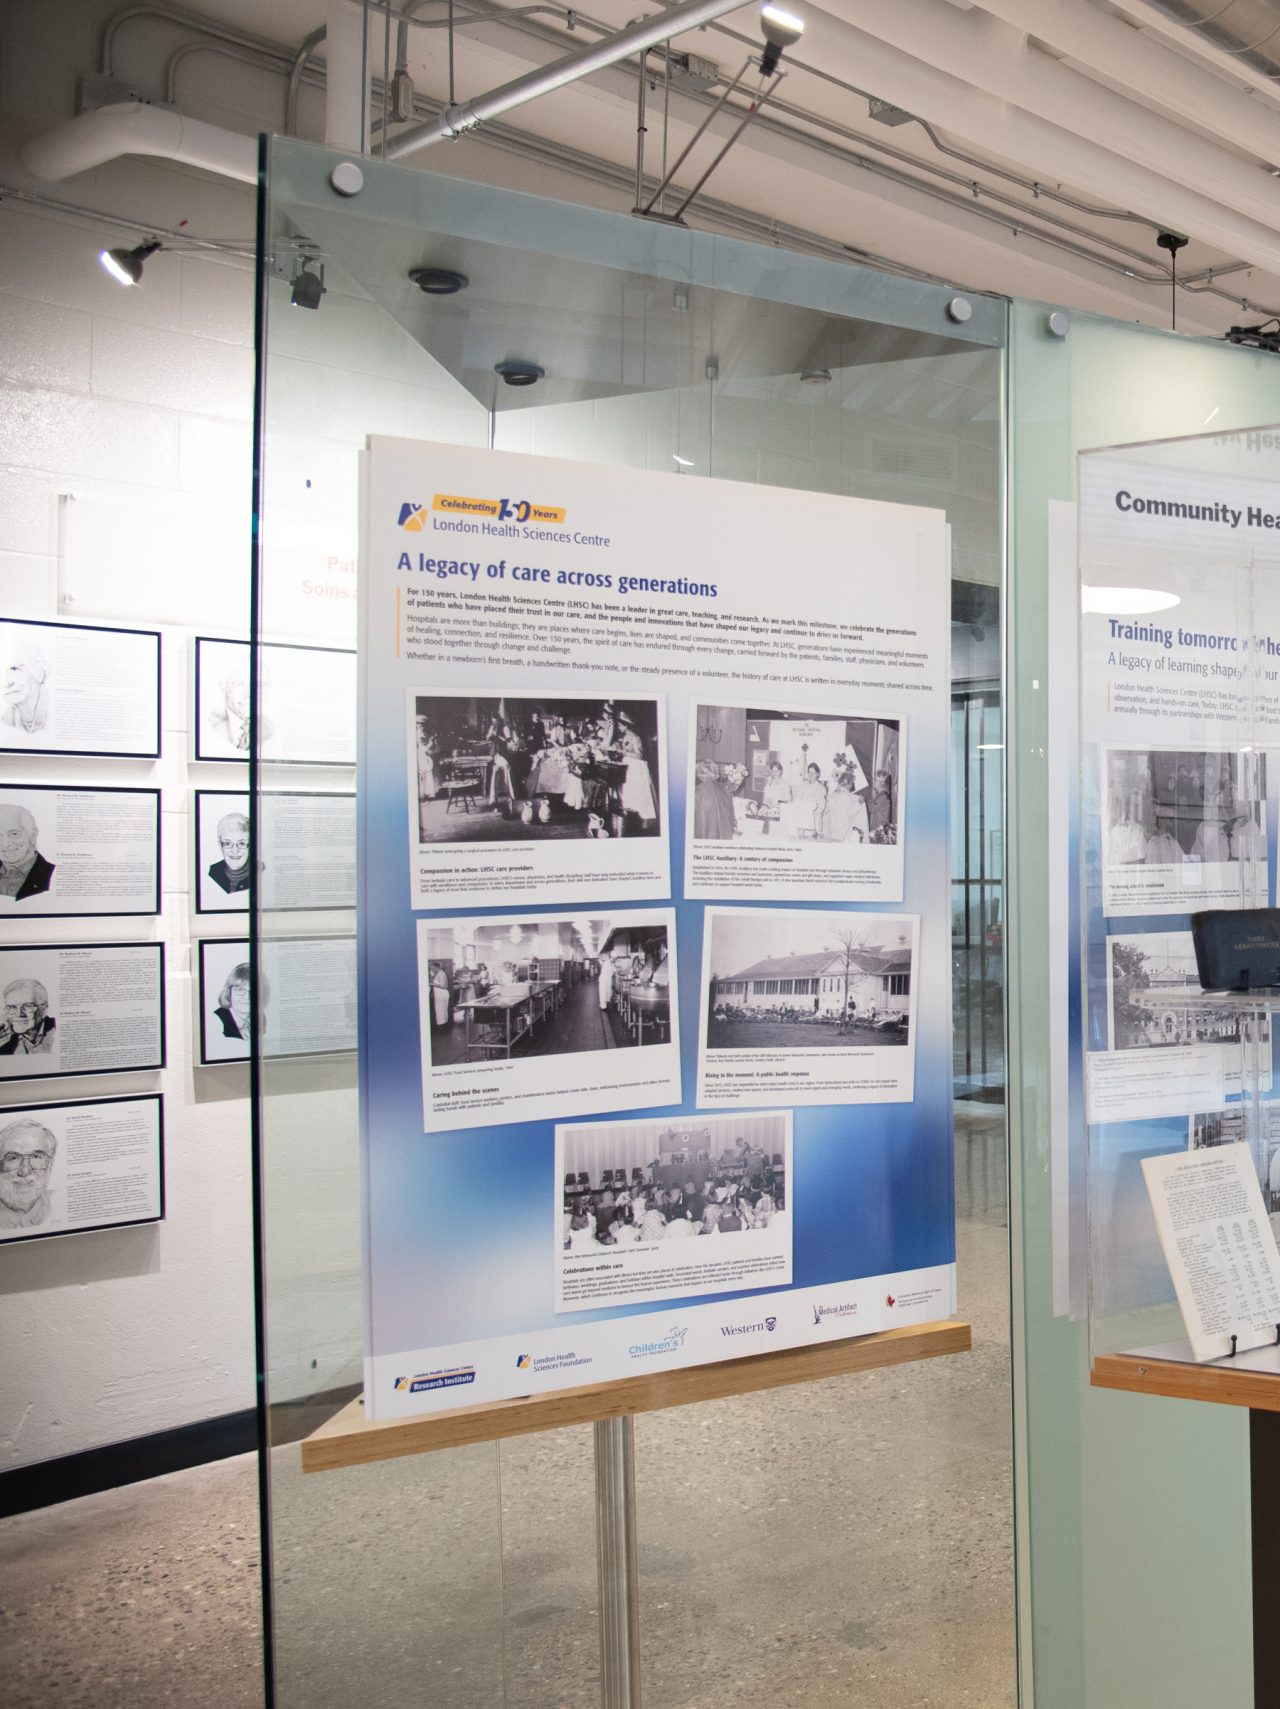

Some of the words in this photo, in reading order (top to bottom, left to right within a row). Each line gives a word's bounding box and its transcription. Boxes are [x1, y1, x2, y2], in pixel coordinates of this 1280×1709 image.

[440, 498, 497, 514] Celebrating
[533, 508, 558, 520] Years
[1115, 491, 1240, 526] Community
[433, 517, 478, 533] London
[481, 522, 519, 537] Health
[522, 526, 570, 542] Sciences
[573, 532, 610, 546] Centre
[397, 552, 411, 570] A
[419, 553, 479, 580] legacy
[486, 560, 505, 578] of
[512, 566, 550, 582] care
[556, 570, 612, 587] across
[618, 576, 716, 596] generations
[406, 587, 419, 597] For
[422, 588, 434, 598] 150
[436, 590, 457, 602] years,
[459, 591, 486, 602] London
[488, 594, 511, 604] Health
[511, 595, 541, 606] Sciences
[542, 598, 565, 608] Centre
[566, 600, 589, 612] (LHSC)
[590, 602, 602, 611] has
[604, 603, 620, 612] been
[626, 605, 647, 615] leader
[647, 606, 655, 615] in
[657, 607, 673, 619] great
[674, 609, 690, 620] care,
[691, 610, 720, 623] teaching,
[719, 612, 732, 621] and
[761, 616, 769, 624] As
[779, 617, 796, 626] mark
[875, 626, 884, 634] the
[1108, 619, 1172, 648] Training
[406, 636, 422, 644] who
[444, 639, 472, 647] together
[473, 640, 500, 650] through
[501, 642, 525, 651] change
[540, 644, 570, 654] challenge.
[1107, 651, 1116, 664] A
[1119, 652, 1151, 671] legacy
[1154, 656, 1165, 669] of
[1167, 657, 1207, 677] learning
[721, 1323, 763, 1335] Western
[533, 1356, 556, 1364] London
[556, 1352, 575, 1362] Health
[628, 1339, 678, 1355] Children's
[533, 1361, 558, 1372] Sciences
[559, 1357, 592, 1367] Foundation
[414, 1380, 444, 1391] Research
[444, 1374, 473, 1385] Institute
